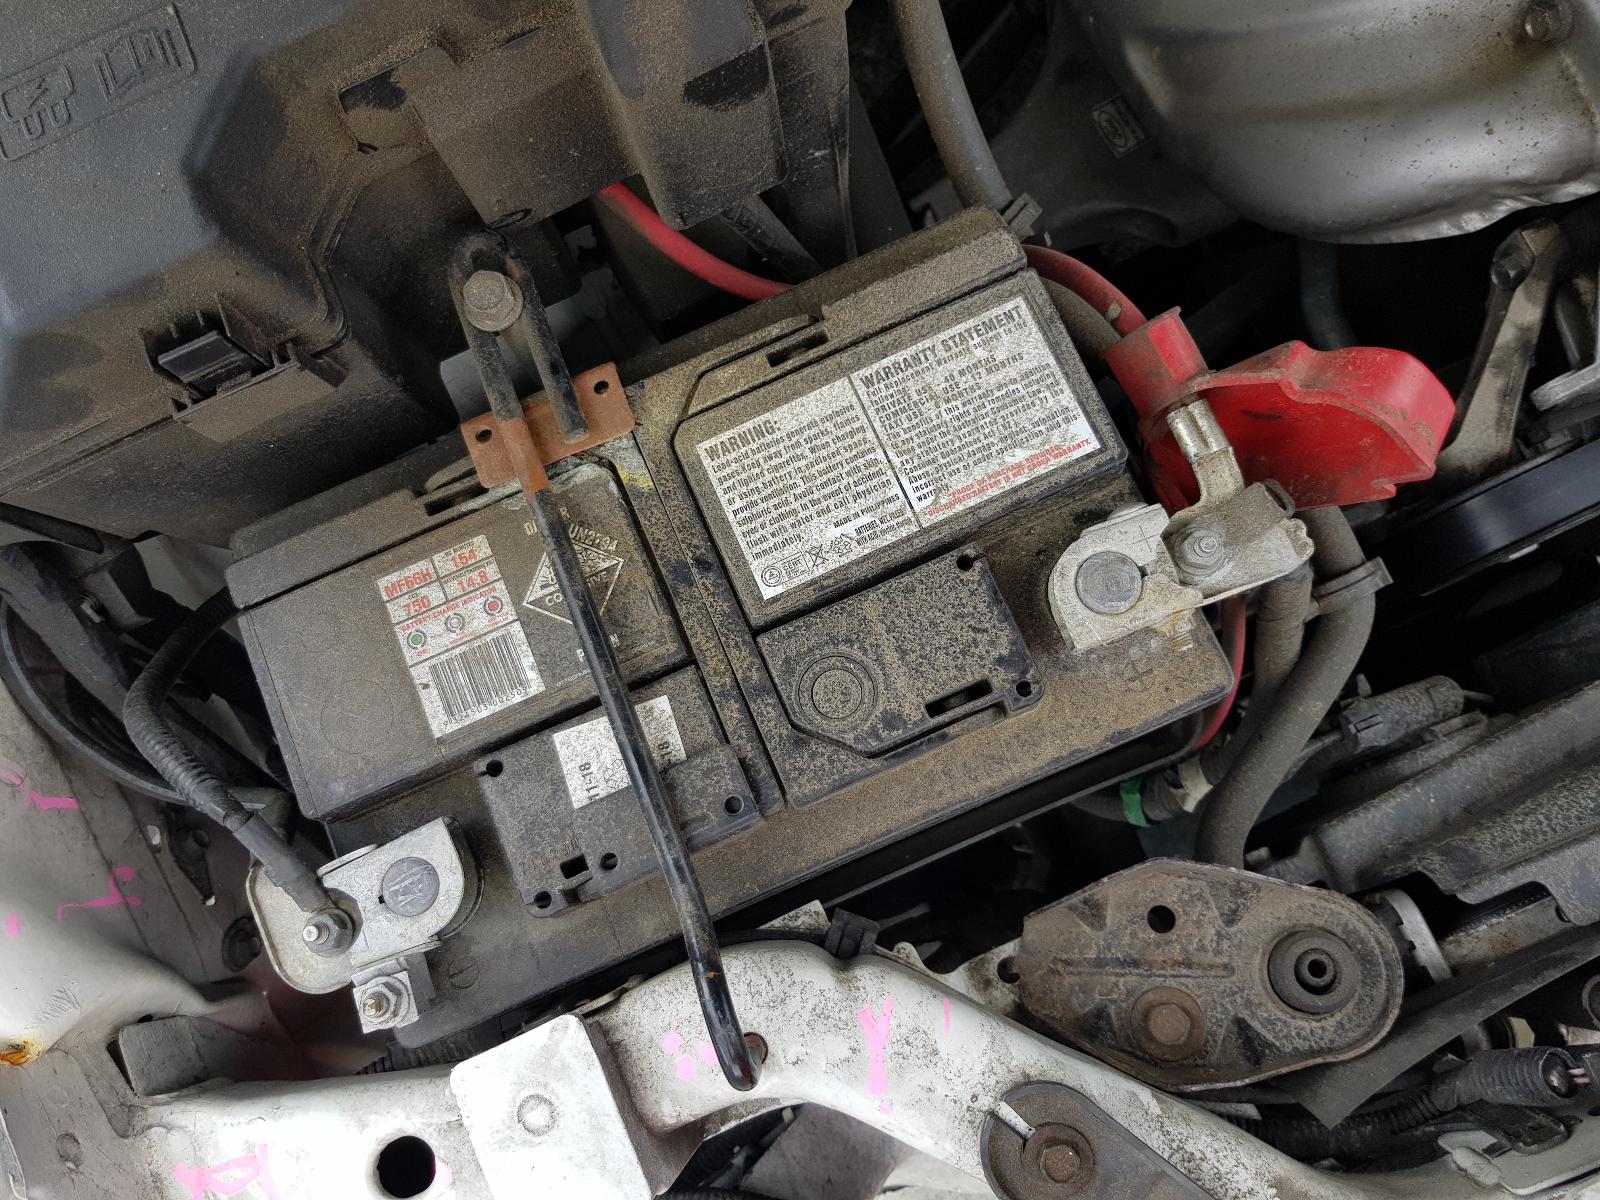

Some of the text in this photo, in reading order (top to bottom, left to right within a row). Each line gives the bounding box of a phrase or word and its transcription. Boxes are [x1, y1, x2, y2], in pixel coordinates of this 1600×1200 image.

[858, 305, 1025, 390] WARRANTY STATEMENT
[971, 331, 1003, 351] subject
[1013, 319, 1028, 331] the
[873, 392, 914, 416] PRIVATE
[957, 354, 997, 378] MONTHS
[877, 389, 941, 424] COMMERCIAL
[941, 380, 961, 395] USE
[984, 352, 1025, 376] MONTHS
[881, 417, 904, 433] TAXI
[904, 407, 924, 422] USE
[941, 381, 982, 405] MONTHS
[885, 429, 901, 441] The
[943, 402, 960, 415] this
[948, 408, 972, 425] rights
[703, 416, 781, 463] WARNING:
[749, 434, 785, 456] batteries
[784, 418, 820, 441] generate
[898, 455, 915, 468] any
[1049, 386, 1065, 399] the
[938, 428, 951, 438] the
[720, 481, 737, 494] and
[737, 468, 766, 488] lighted
[807, 439, 831, 455] When
[830, 423, 866, 446] charging
[761, 449, 783, 465] away
[933, 453, 966, 474] physical
[946, 466, 961, 477] use
[993, 428, 1045, 457] specification
[730, 497, 759, 518] provide
[800, 471, 818, 486] This
[816, 459, 845, 480] battery
[843, 444, 877, 466] contains
[736, 484, 761, 502] using
[761, 469, 793, 491] battery
[1011, 467, 1027, 479] NOT
[735, 504, 772, 528] sulphuric
[791, 485, 814, 502] Avoid
[813, 472, 844, 492] contact
[843, 464, 862, 478] with
[741, 524, 759, 539] eyes
[808, 495, 822, 507] the
[821, 485, 843, 501] event
[745, 477, 893, 548] flush with water and call physician
[832, 514, 852, 528] MADE
[860, 493, 900, 516] PHILIPPINES
[449, 547, 478, 570] 154
[750, 530, 804, 562] immediately.
[456, 567, 490, 593] 14.8
[401, 593, 432, 617] 750
